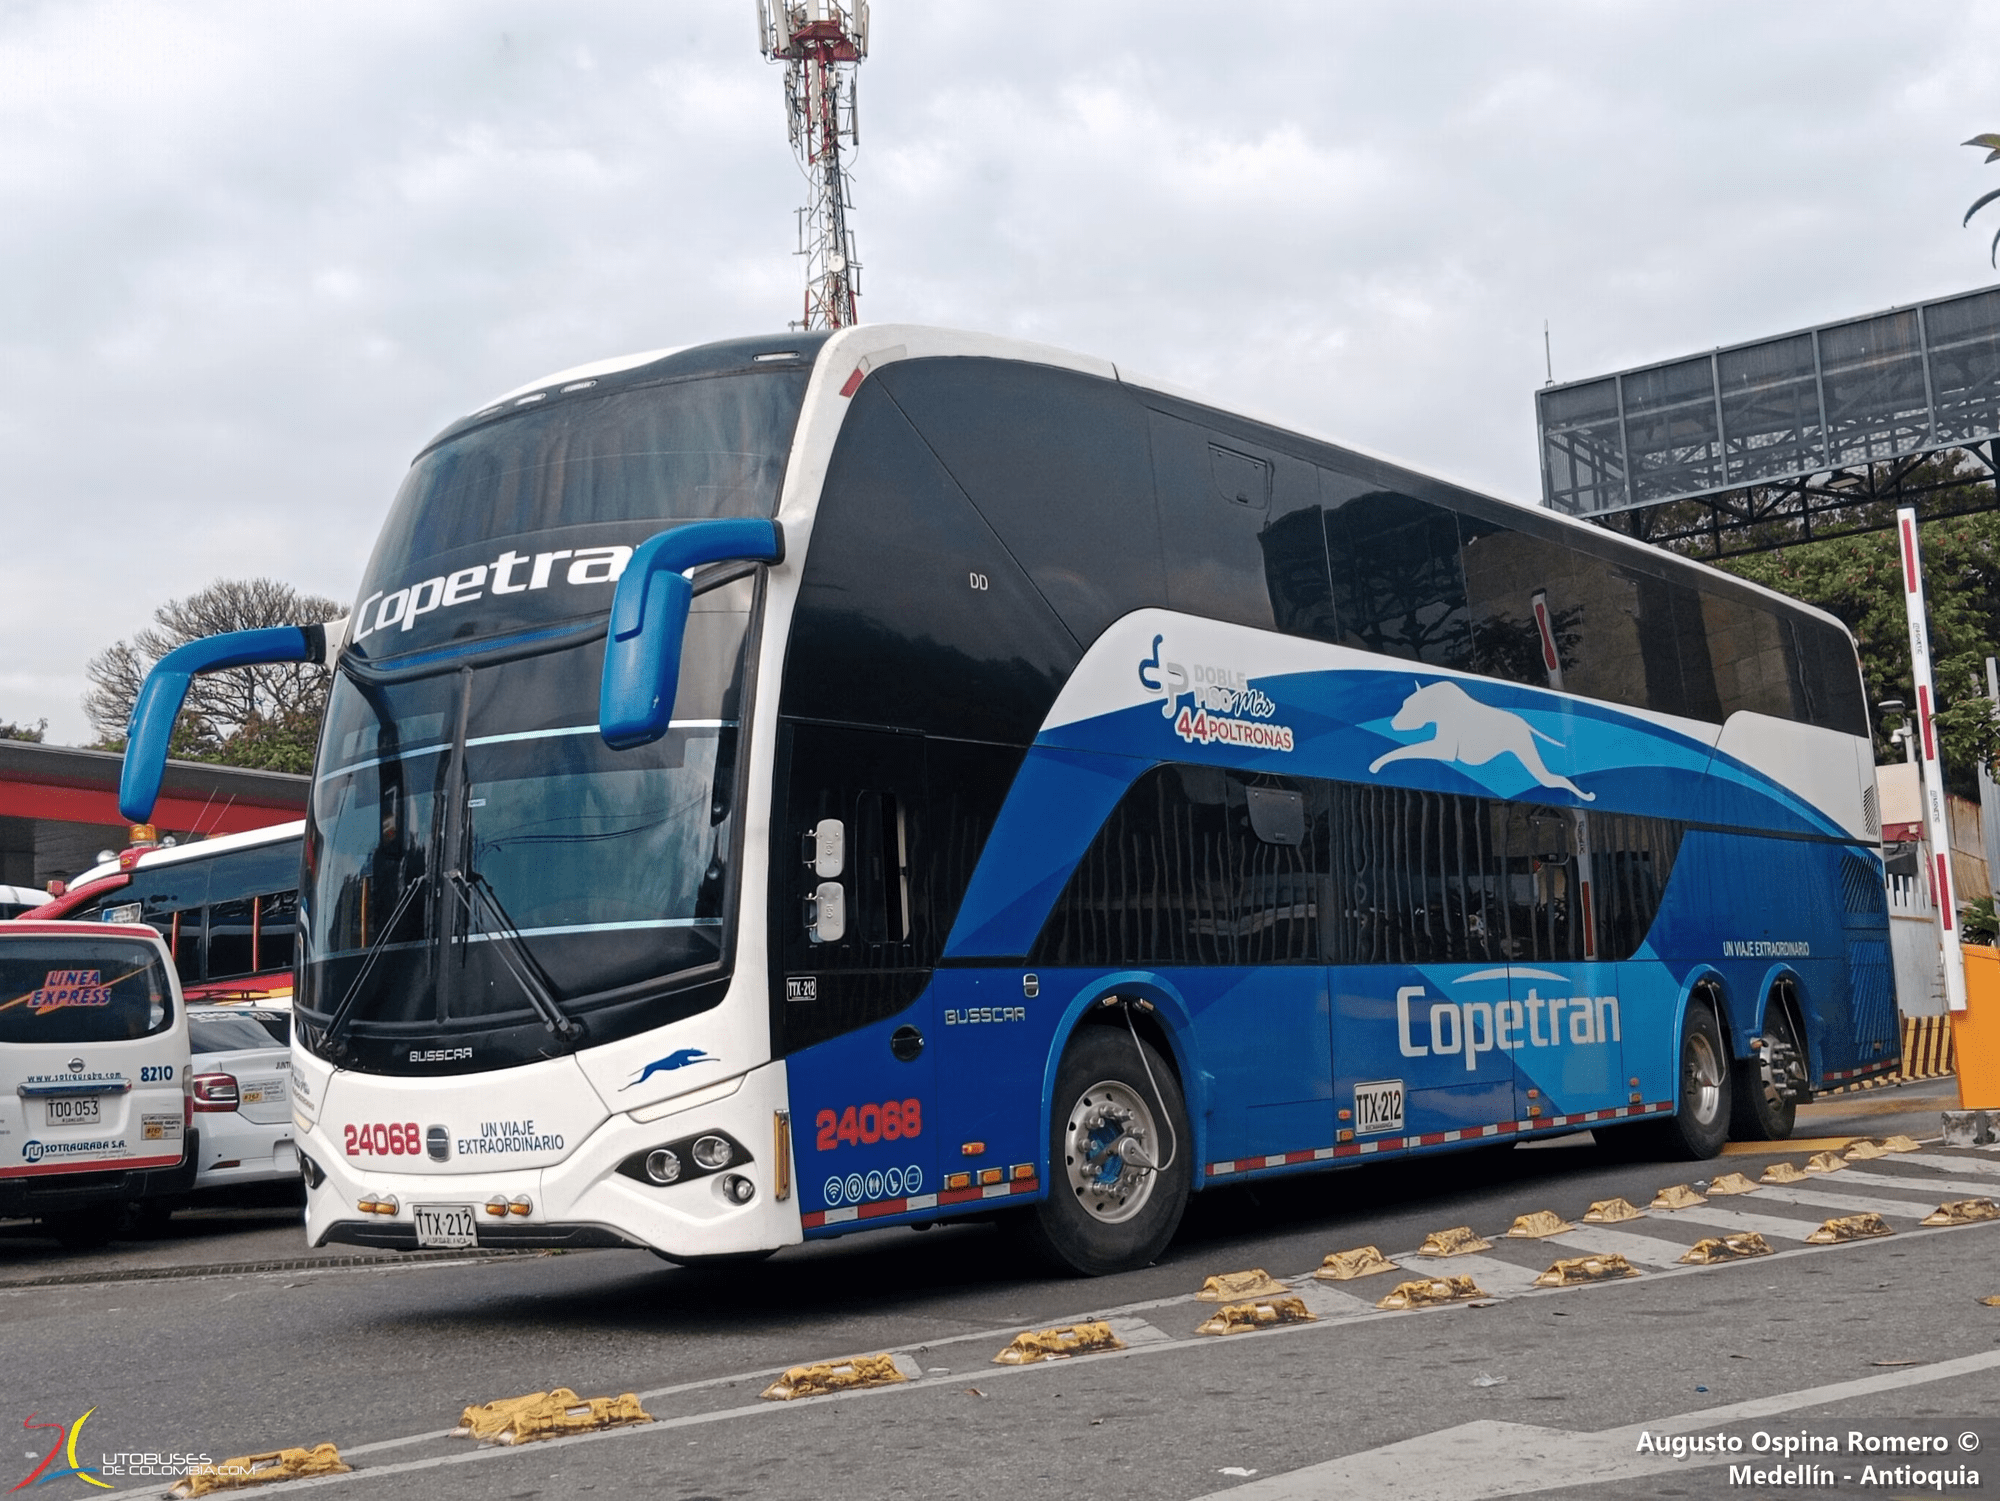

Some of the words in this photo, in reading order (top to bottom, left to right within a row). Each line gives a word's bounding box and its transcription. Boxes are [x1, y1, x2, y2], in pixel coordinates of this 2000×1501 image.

[970, 572, 988, 590] DD
[352, 544, 640, 645] Copetra
[1194, 664, 1246, 691] DOBLE
[1194, 686, 1233, 713] PISO
[1231, 688, 1275, 717] Más
[1177, 711, 1208, 741] 44
[1208, 720, 1293, 750] POLTRONAS
[1722, 940, 1734, 957] UN
[1734, 940, 1755, 957] VIAJE
[31, 988, 111, 1006] EXPRESS
[944, 1006, 1026, 1026] BUSSCAR
[1396, 985, 1622, 1071] Copetran
[409, 1047, 473, 1062] BUSSCAR
[140, 1065, 174, 1082] 8210
[480, 1122, 498, 1138] UN
[499, 1120, 535, 1137] VIAJE
[816, 1098, 922, 1151] 24068
[45, 1140, 109, 1153] SOTRAURABA
[111, 1140, 128, 1149] S.A.
[344, 1122, 422, 1156] 24068
[458, 1134, 564, 1155] EXTRAORDINARIO
